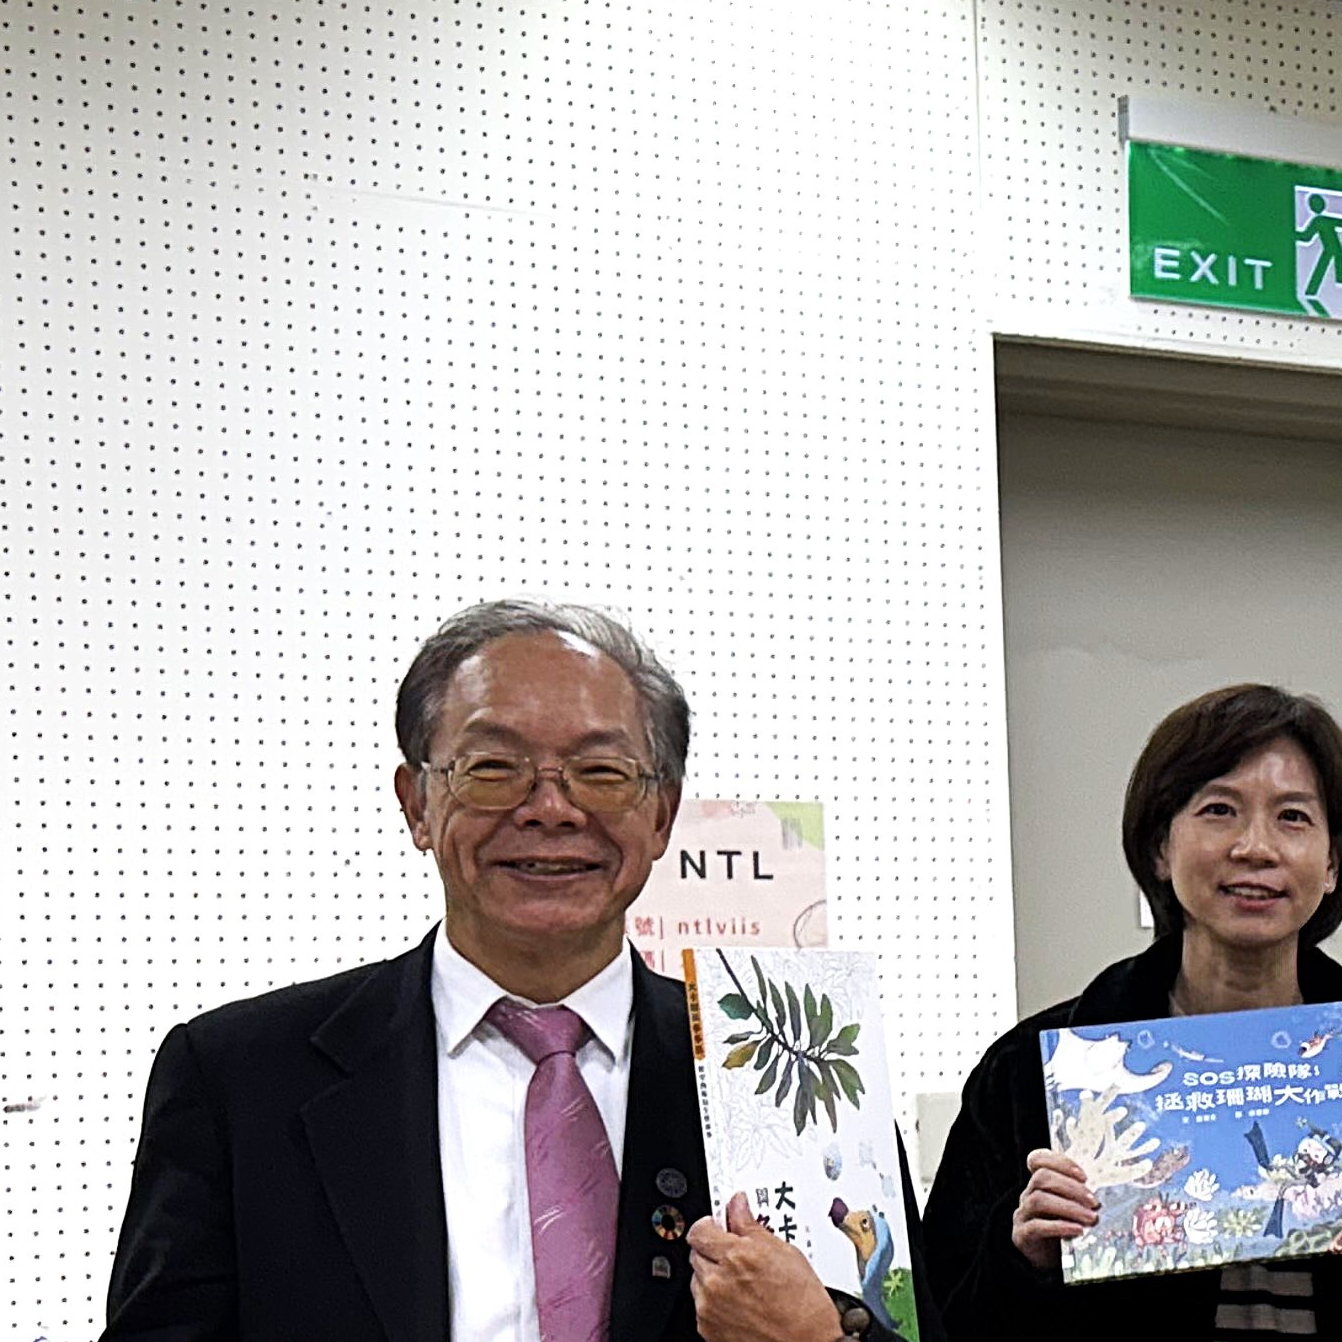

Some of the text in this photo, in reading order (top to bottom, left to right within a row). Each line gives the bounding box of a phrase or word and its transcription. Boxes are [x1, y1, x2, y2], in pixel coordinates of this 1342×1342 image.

[1153, 247, 1273, 291] EXIT
[680, 849, 774, 880] NTL
[678, 917, 761, 936] ntlviis
